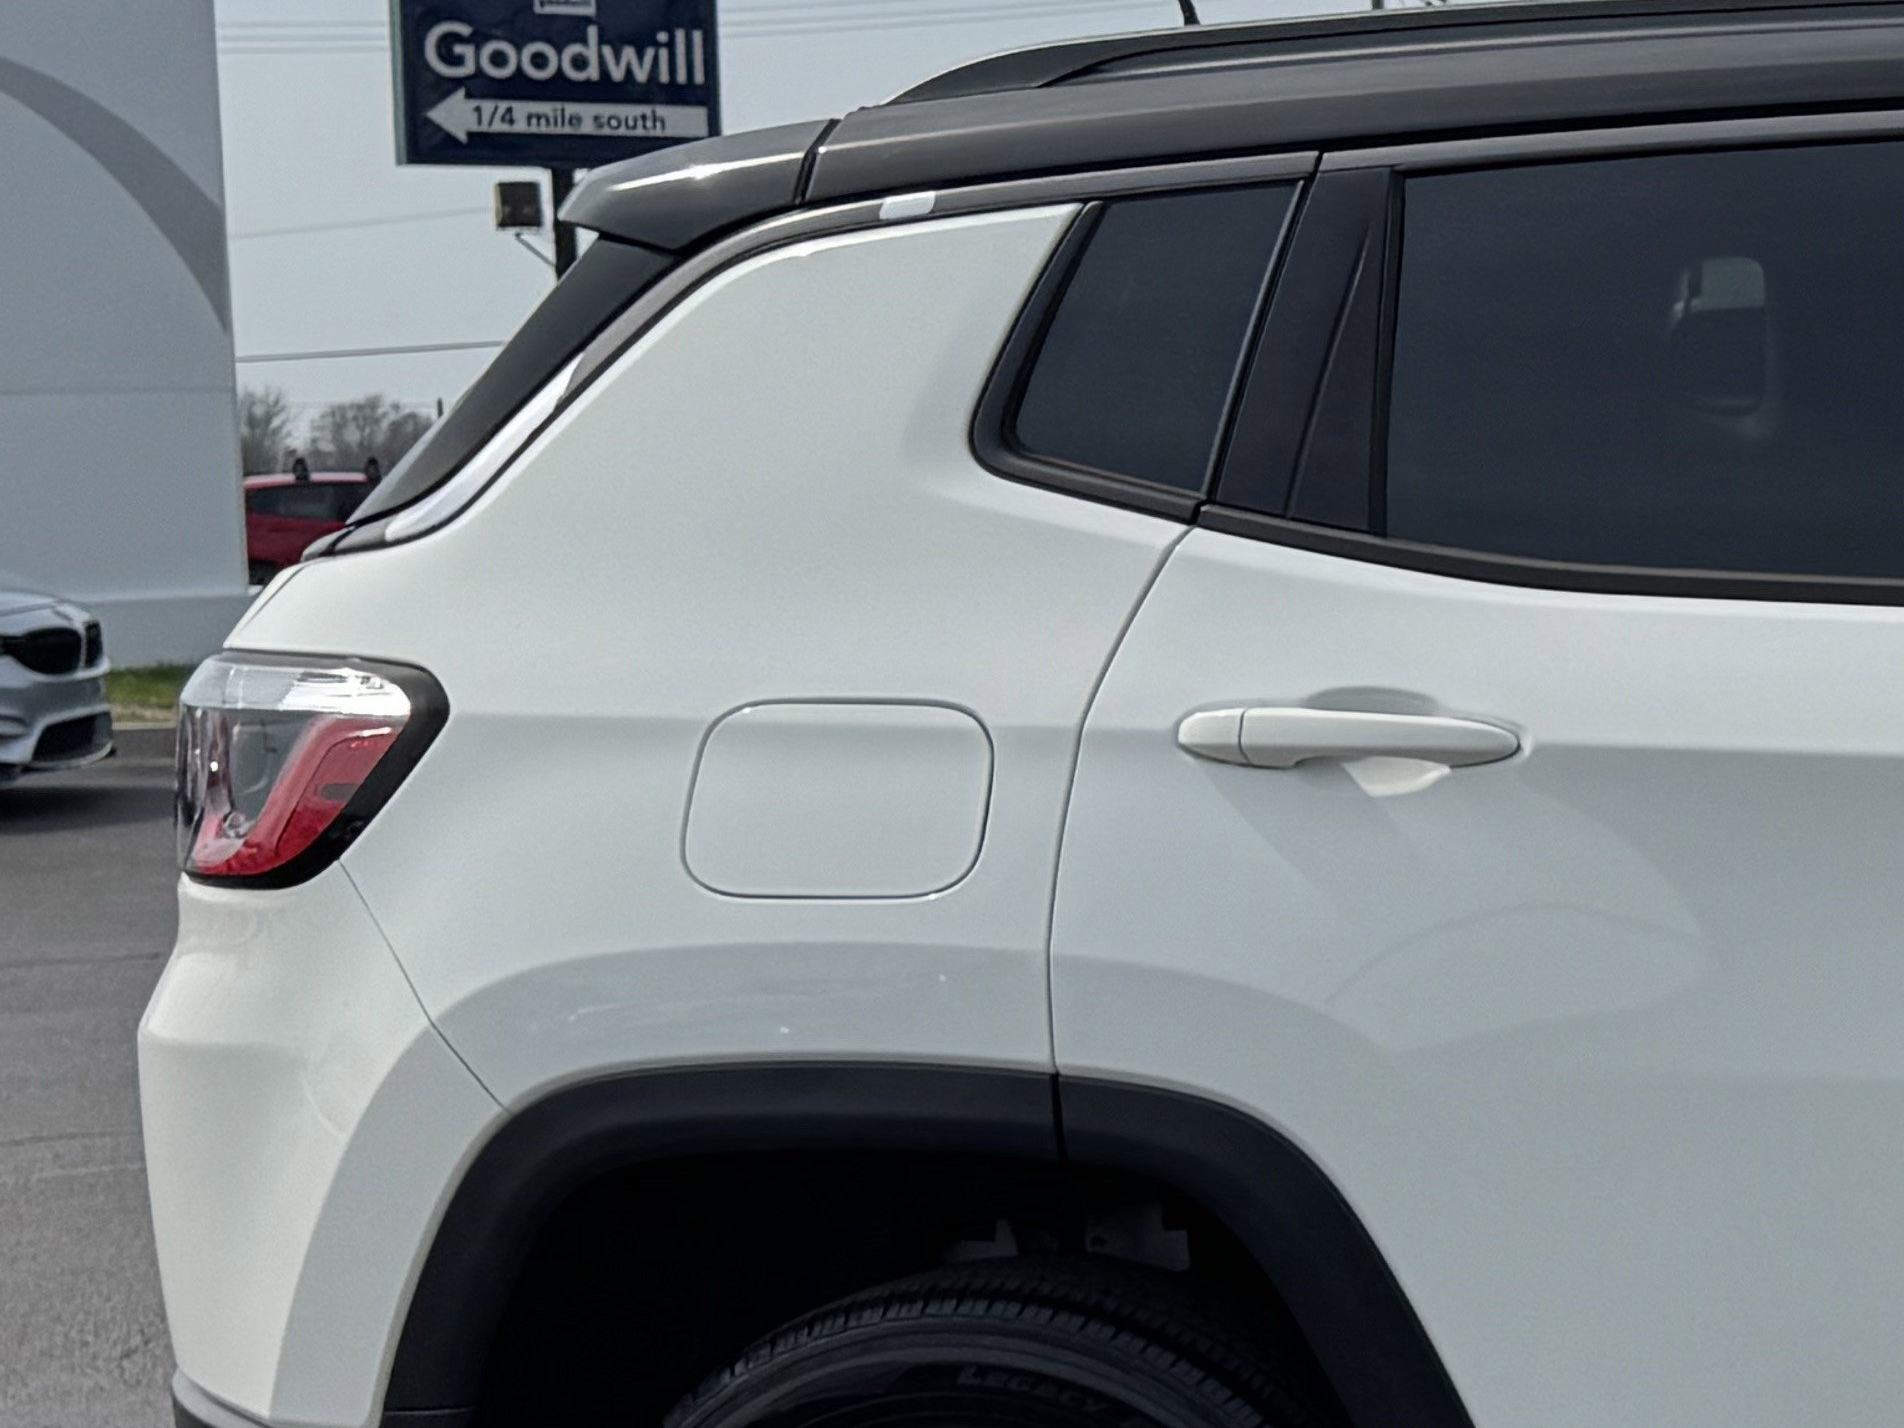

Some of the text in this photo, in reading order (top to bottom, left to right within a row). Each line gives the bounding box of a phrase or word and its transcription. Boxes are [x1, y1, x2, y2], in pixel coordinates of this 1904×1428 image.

[424, 20, 706, 85] Goodwill
[472, 104, 667, 133] 1/4 mile south
